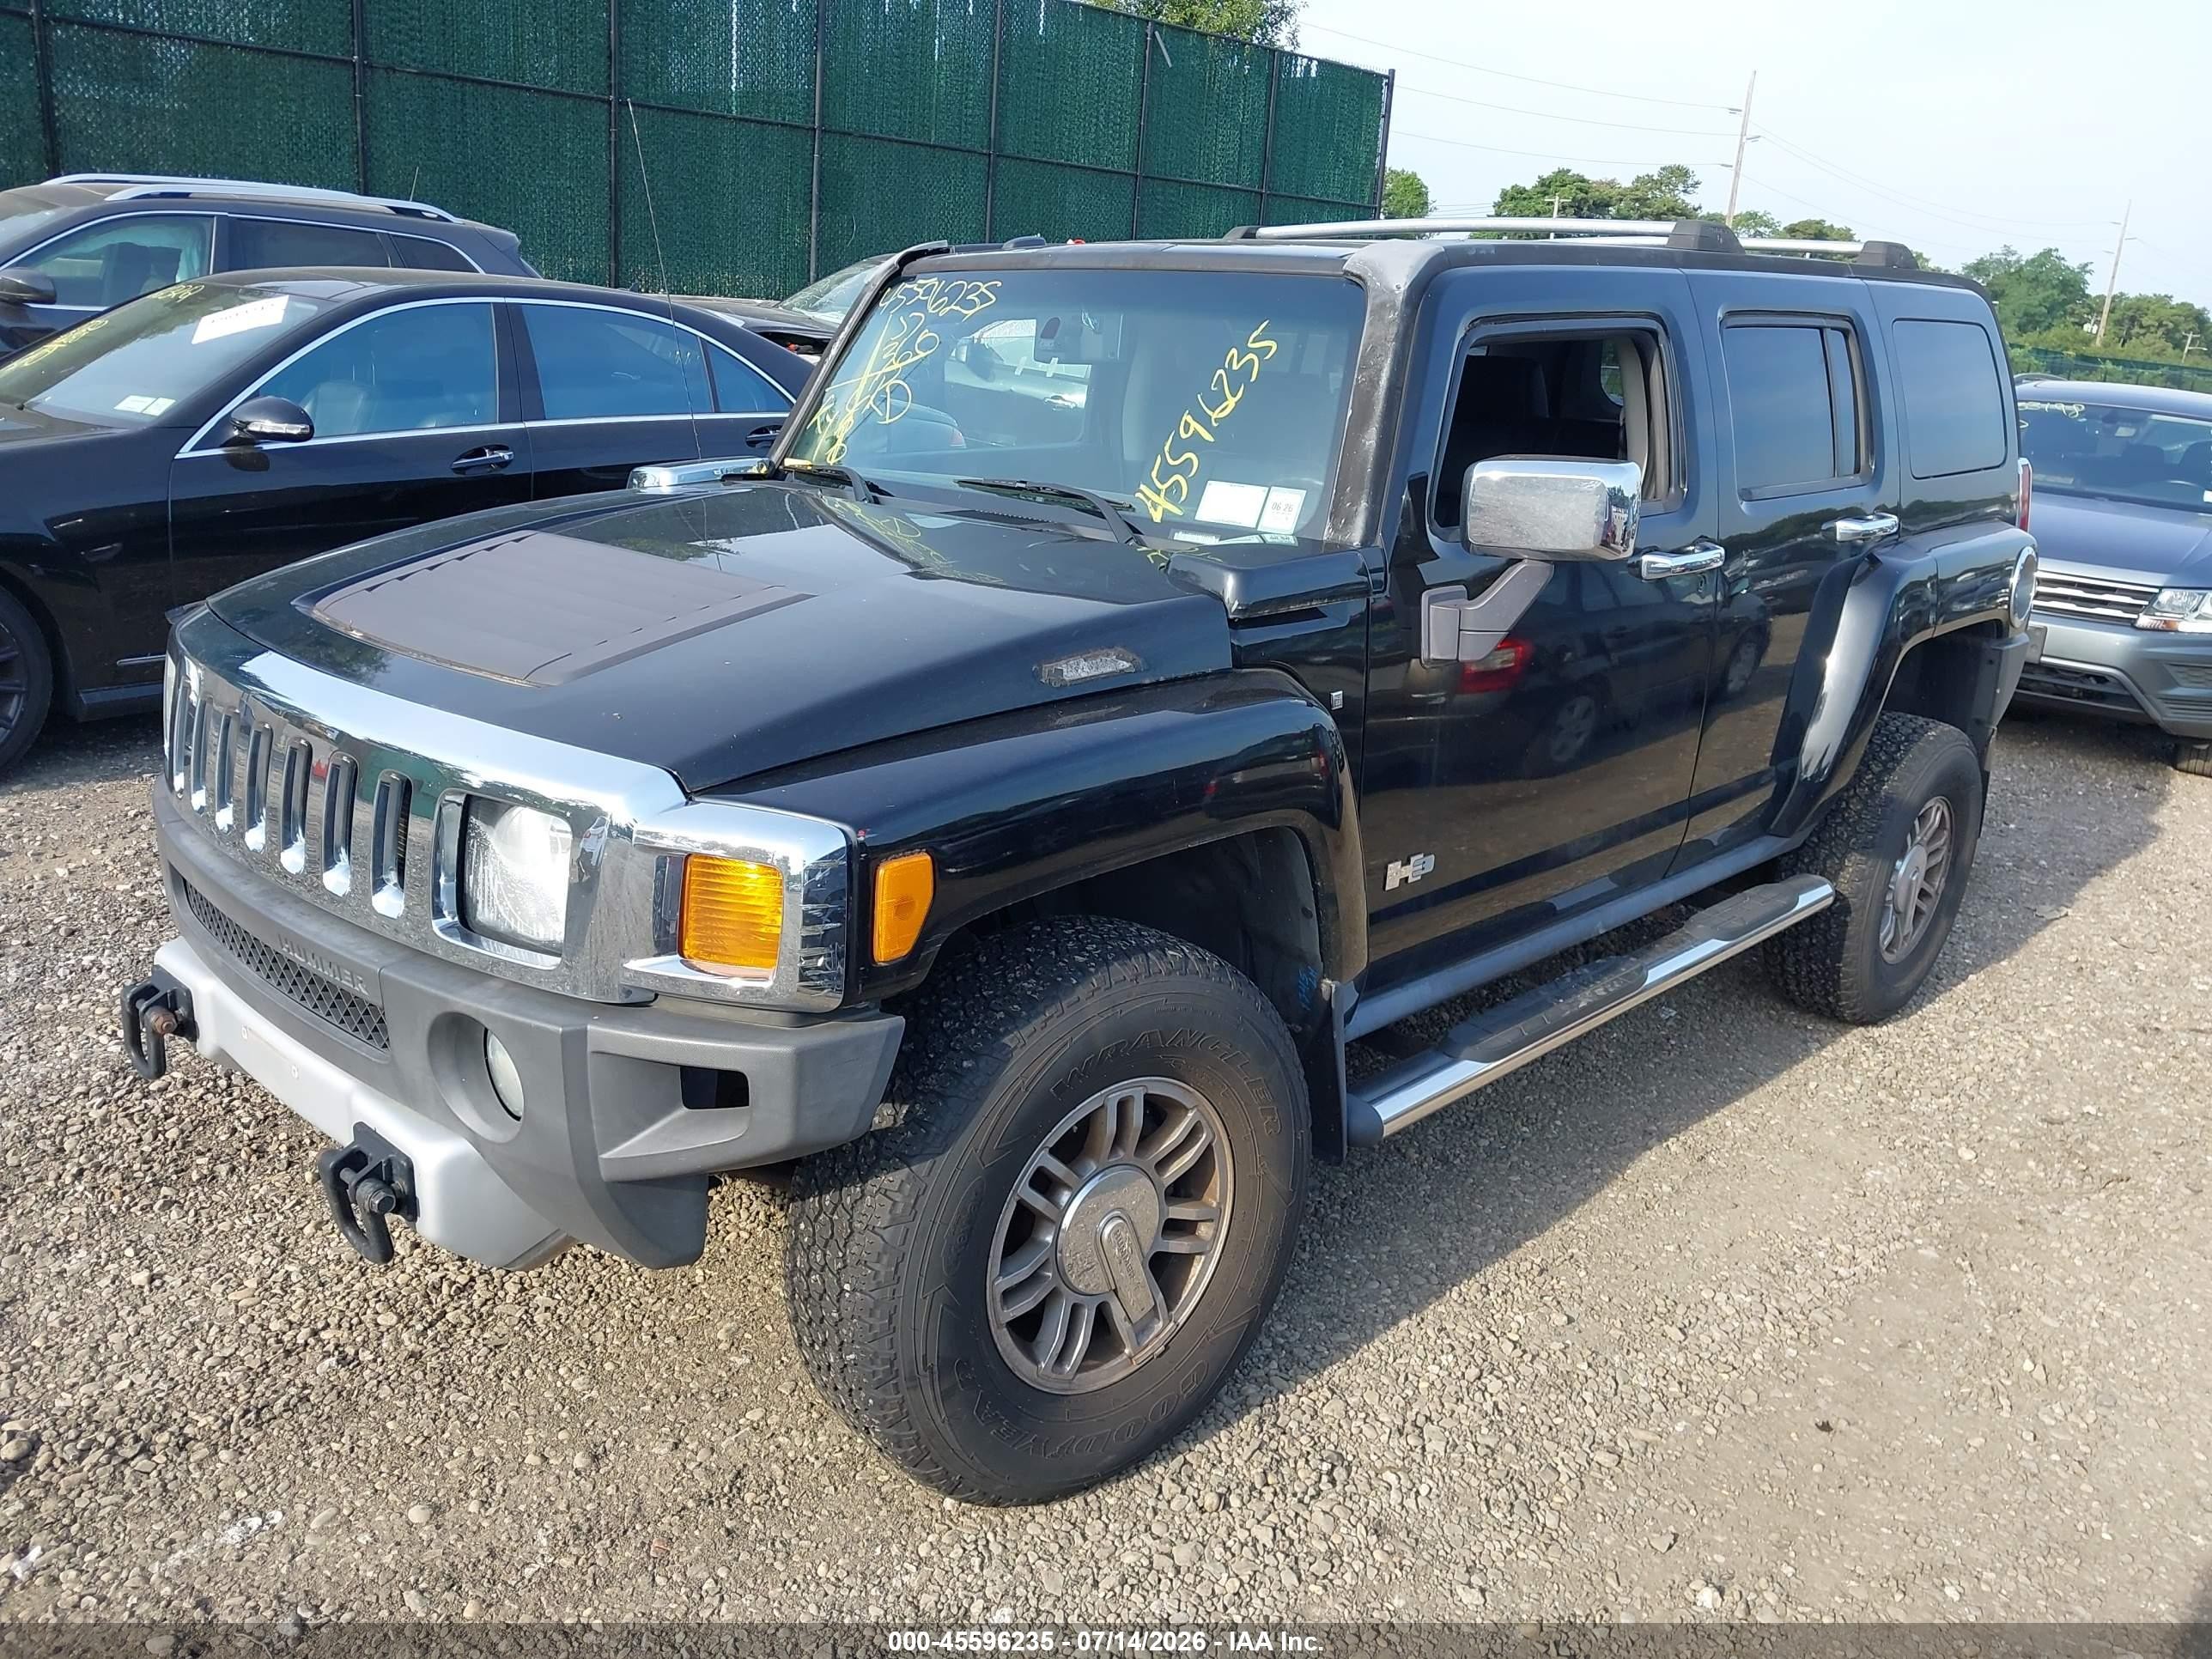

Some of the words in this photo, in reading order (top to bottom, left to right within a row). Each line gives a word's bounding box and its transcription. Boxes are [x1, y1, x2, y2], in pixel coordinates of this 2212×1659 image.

[1135, 319, 1277, 522] 45596235
[1385, 852, 1435, 890] H3
[277, 933, 369, 996] HUMMER
[1049, 1029, 1282, 1135] WRANGLER
